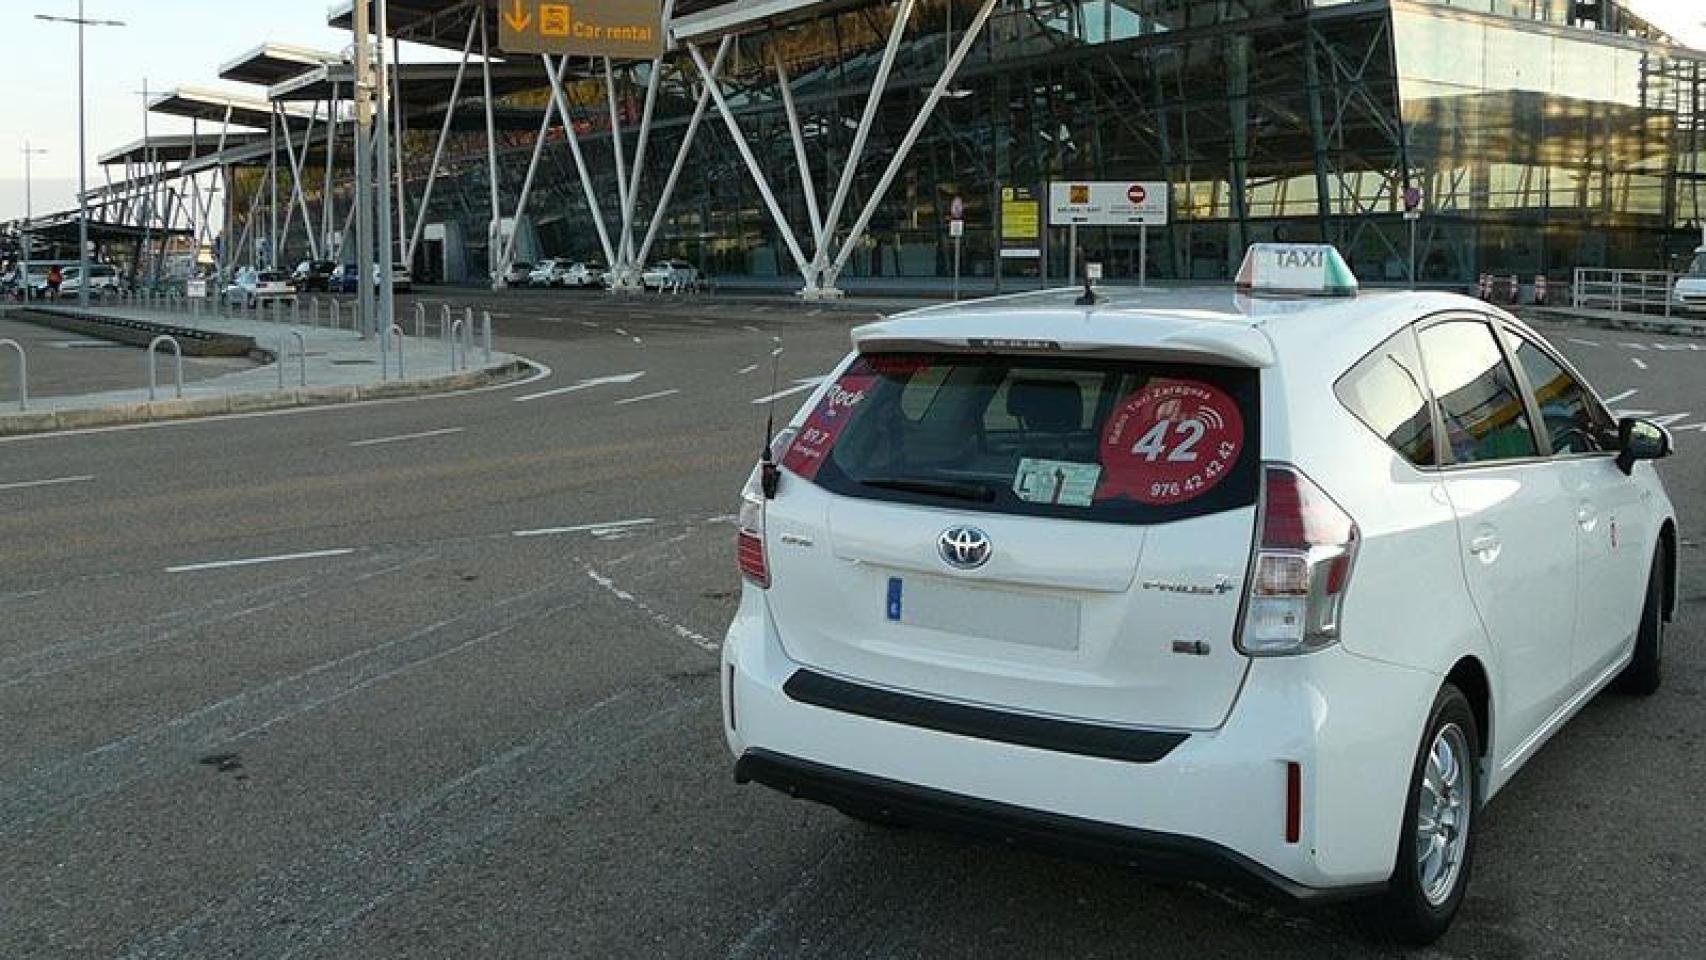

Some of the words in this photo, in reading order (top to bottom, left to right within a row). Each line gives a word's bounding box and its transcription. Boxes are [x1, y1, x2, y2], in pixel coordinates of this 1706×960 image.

[574, 22, 601, 39] Car
[607, 25, 651, 40] rental
[1276, 249, 1323, 268] TAXI
[1131, 419, 1206, 462] 42
[1150, 481, 1180, 496] 976
[1183, 475, 1204, 491] 42
[1205, 459, 1225, 479] 42
[1218, 440, 1236, 460] 42
